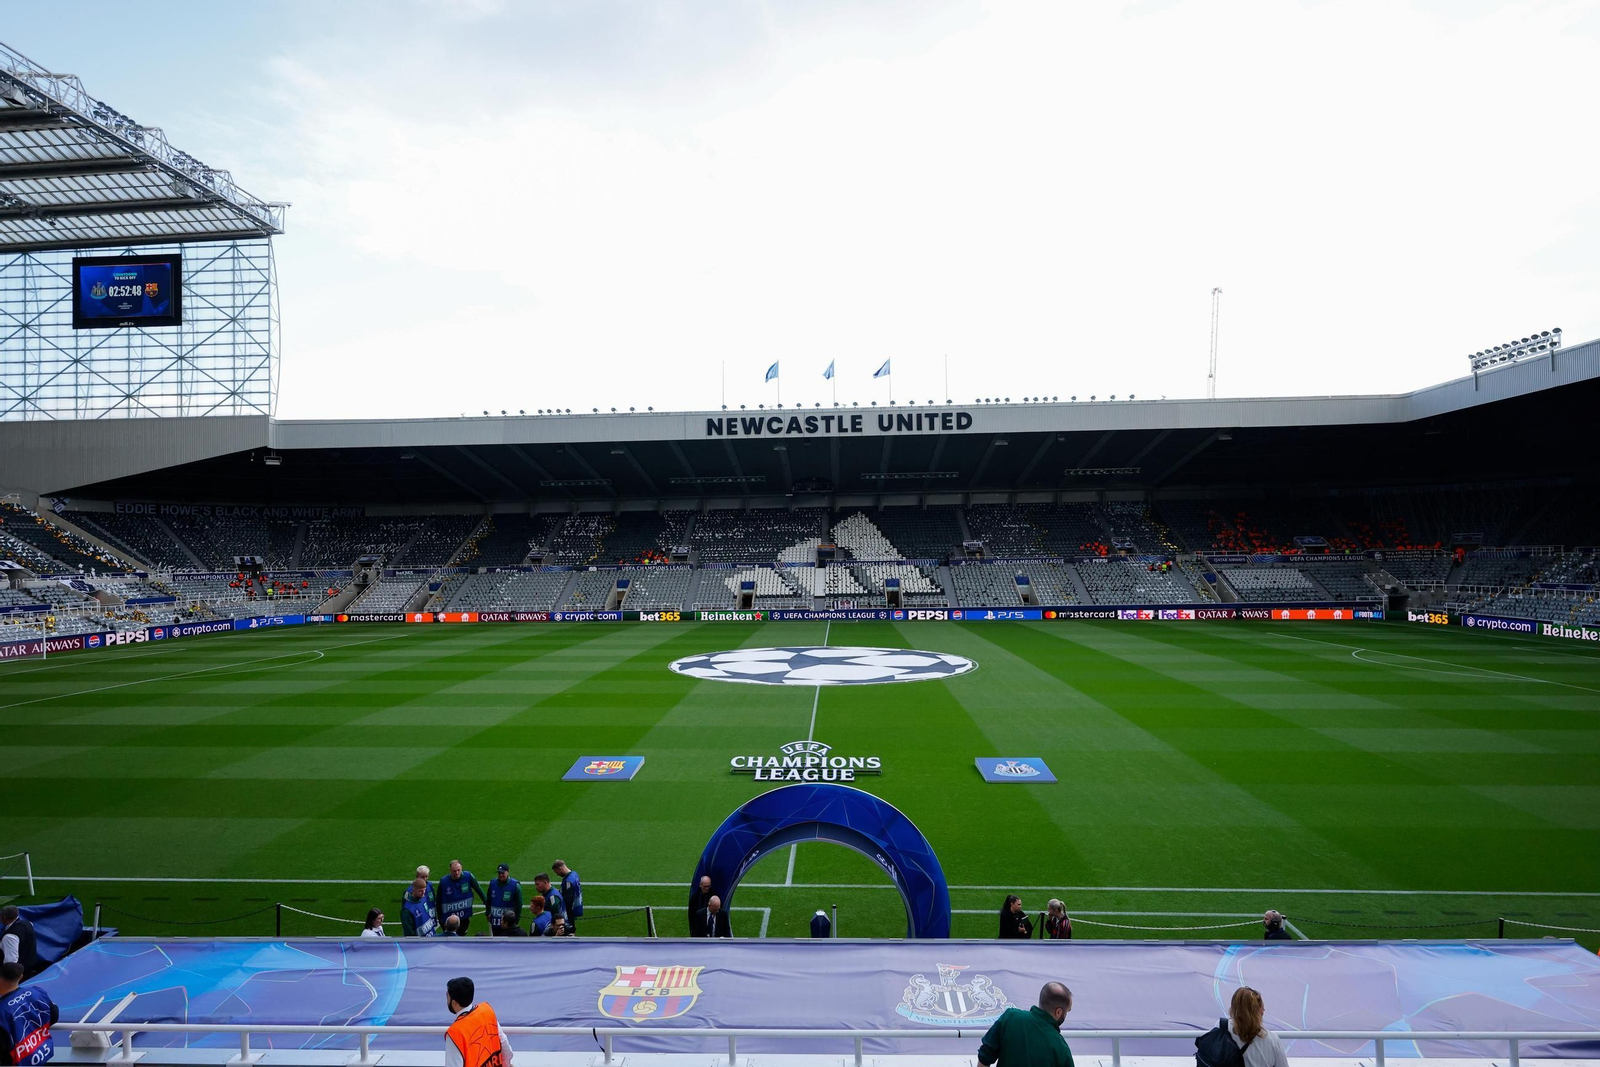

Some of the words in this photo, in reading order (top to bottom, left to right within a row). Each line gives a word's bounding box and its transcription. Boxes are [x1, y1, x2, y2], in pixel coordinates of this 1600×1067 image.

[108, 285, 142, 297] 02:52:48
[707, 414, 863, 436] NEWCASTLE
[878, 411, 973, 432] UNITED
[116, 503, 156, 515] EDDIE
[160, 505, 211, 516] HOWE'S
[215, 506, 258, 516] BLACK
[262, 507, 288, 517] AND
[291, 507, 329, 517] WHITE
[332, 506, 363, 517] ARMY
[350, 613, 404, 622] mastercard
[480, 613, 509, 622] QATAR
[565, 612, 617, 622] cryptocom
[640, 611, 680, 621] bet365
[700, 611, 753, 621] Heineken
[908, 610, 948, 620] PEPSI
[997, 611, 1024, 619] PS5
[1121, 610, 1151, 620] FedEx
[1161, 610, 1191, 620] FedEx
[1198, 610, 1228, 619] QATAR
[1231, 610, 1269, 618] ARWAYS
[1407, 611, 1449, 624] bet365
[259, 617, 284, 626] PS5
[1476, 619, 1531, 632] crypto.com
[183, 622, 231, 635] crypto.com
[1542, 623, 1600, 642] Heineke
[106, 629, 150, 646] PEPSI
[0, 644, 26, 657] TAR
[32, 638, 80, 654] AIRWAYS
[781, 743, 829, 755] UEFA
[730, 755, 881, 768] CHAMPIONS
[753, 768, 856, 781] LEAGUE
[447, 900, 468, 911] PITCH
[630, 987, 671, 996] FCB
[8, 990, 32, 1006] oppo
[915, 1014, 967, 1024] NEWCASTLE
[31, 1043, 51, 1065] 015
